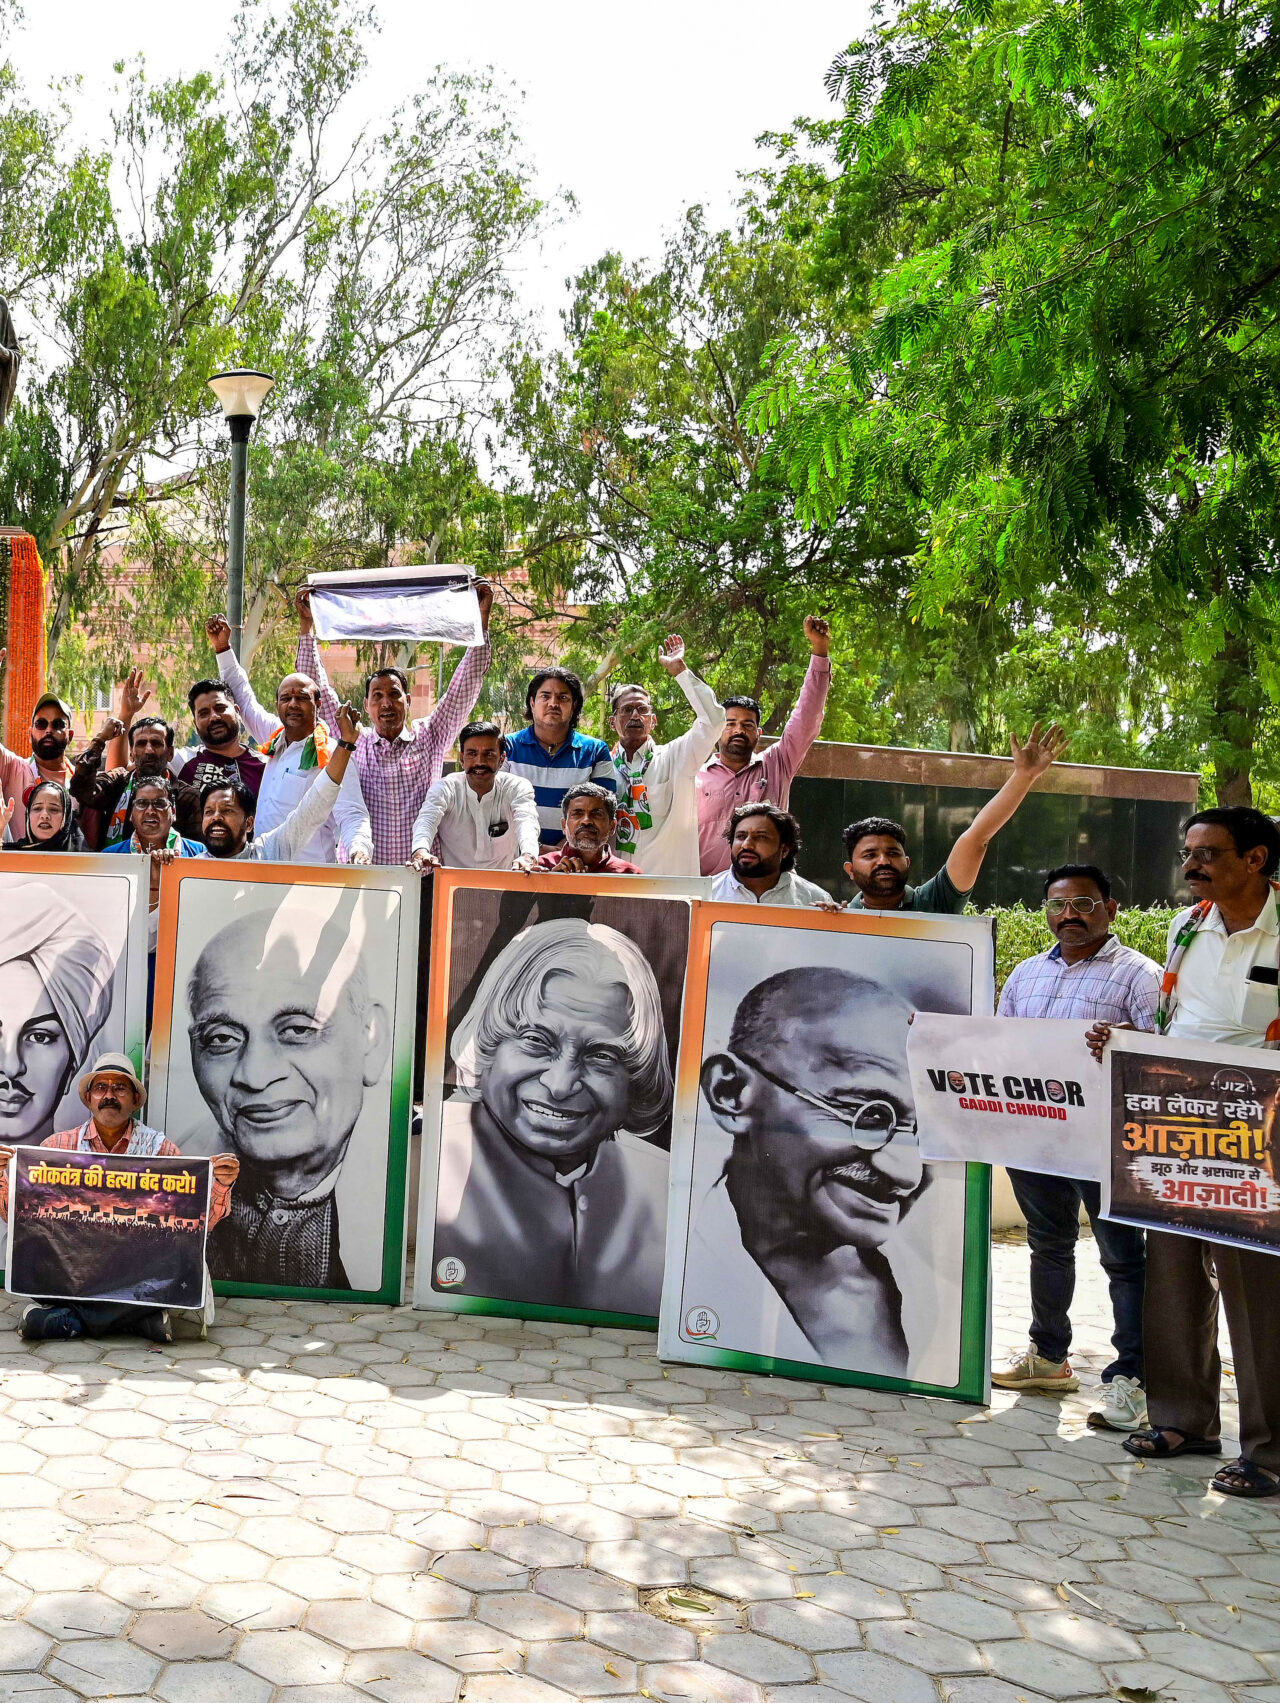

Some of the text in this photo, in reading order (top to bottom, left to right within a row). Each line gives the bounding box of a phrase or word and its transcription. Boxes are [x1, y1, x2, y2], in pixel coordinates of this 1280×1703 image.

[926, 1068, 1086, 1107] VOTE CHOR
[959, 1097, 1067, 1121] GADDI CHHODD
[1124, 1093, 1264, 1120] हम लेकर रहेंगे
[1122, 1120, 1265, 1160] आज़ादी!
[27, 1160, 197, 1194] लोकतंत्र की हत्या बंद करो!
[1150, 1162, 1173, 1176] झूठ
[1176, 1162, 1198, 1175] और
[1249, 1168, 1261, 1180] से
[1161, 1179, 1268, 1209] आज़ादी!
